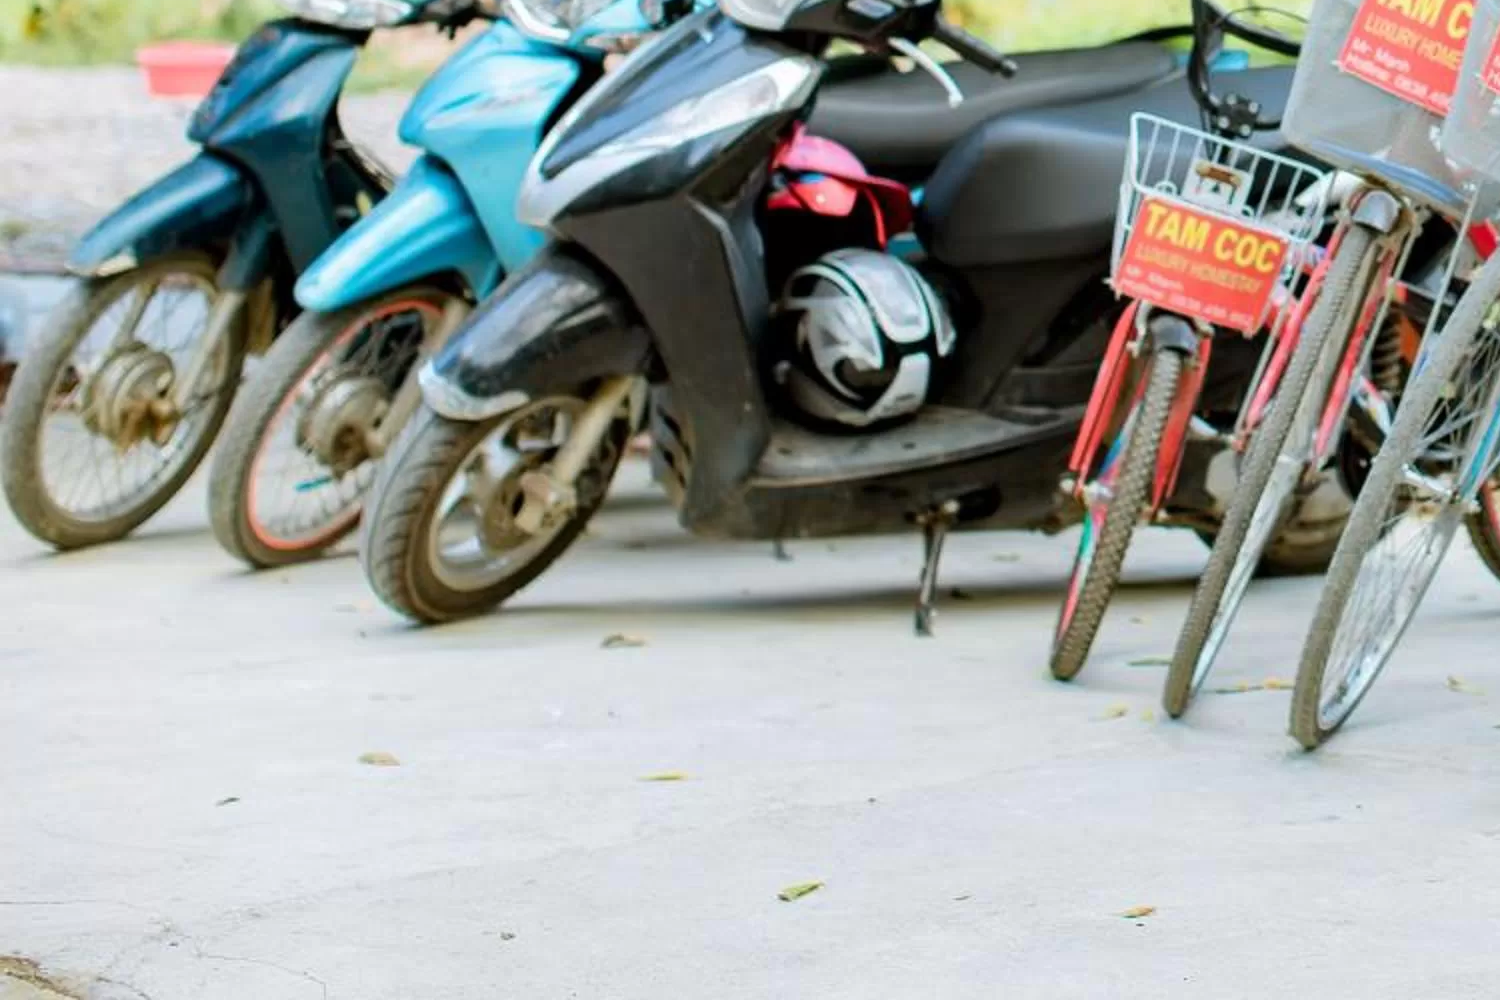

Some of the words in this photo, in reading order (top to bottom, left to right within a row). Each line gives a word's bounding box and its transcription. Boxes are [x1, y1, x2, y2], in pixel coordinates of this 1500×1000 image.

[1363, 12, 1424, 50] LUXURY
[1144, 202, 1211, 252] TAM
[1214, 227, 1281, 273] COC
